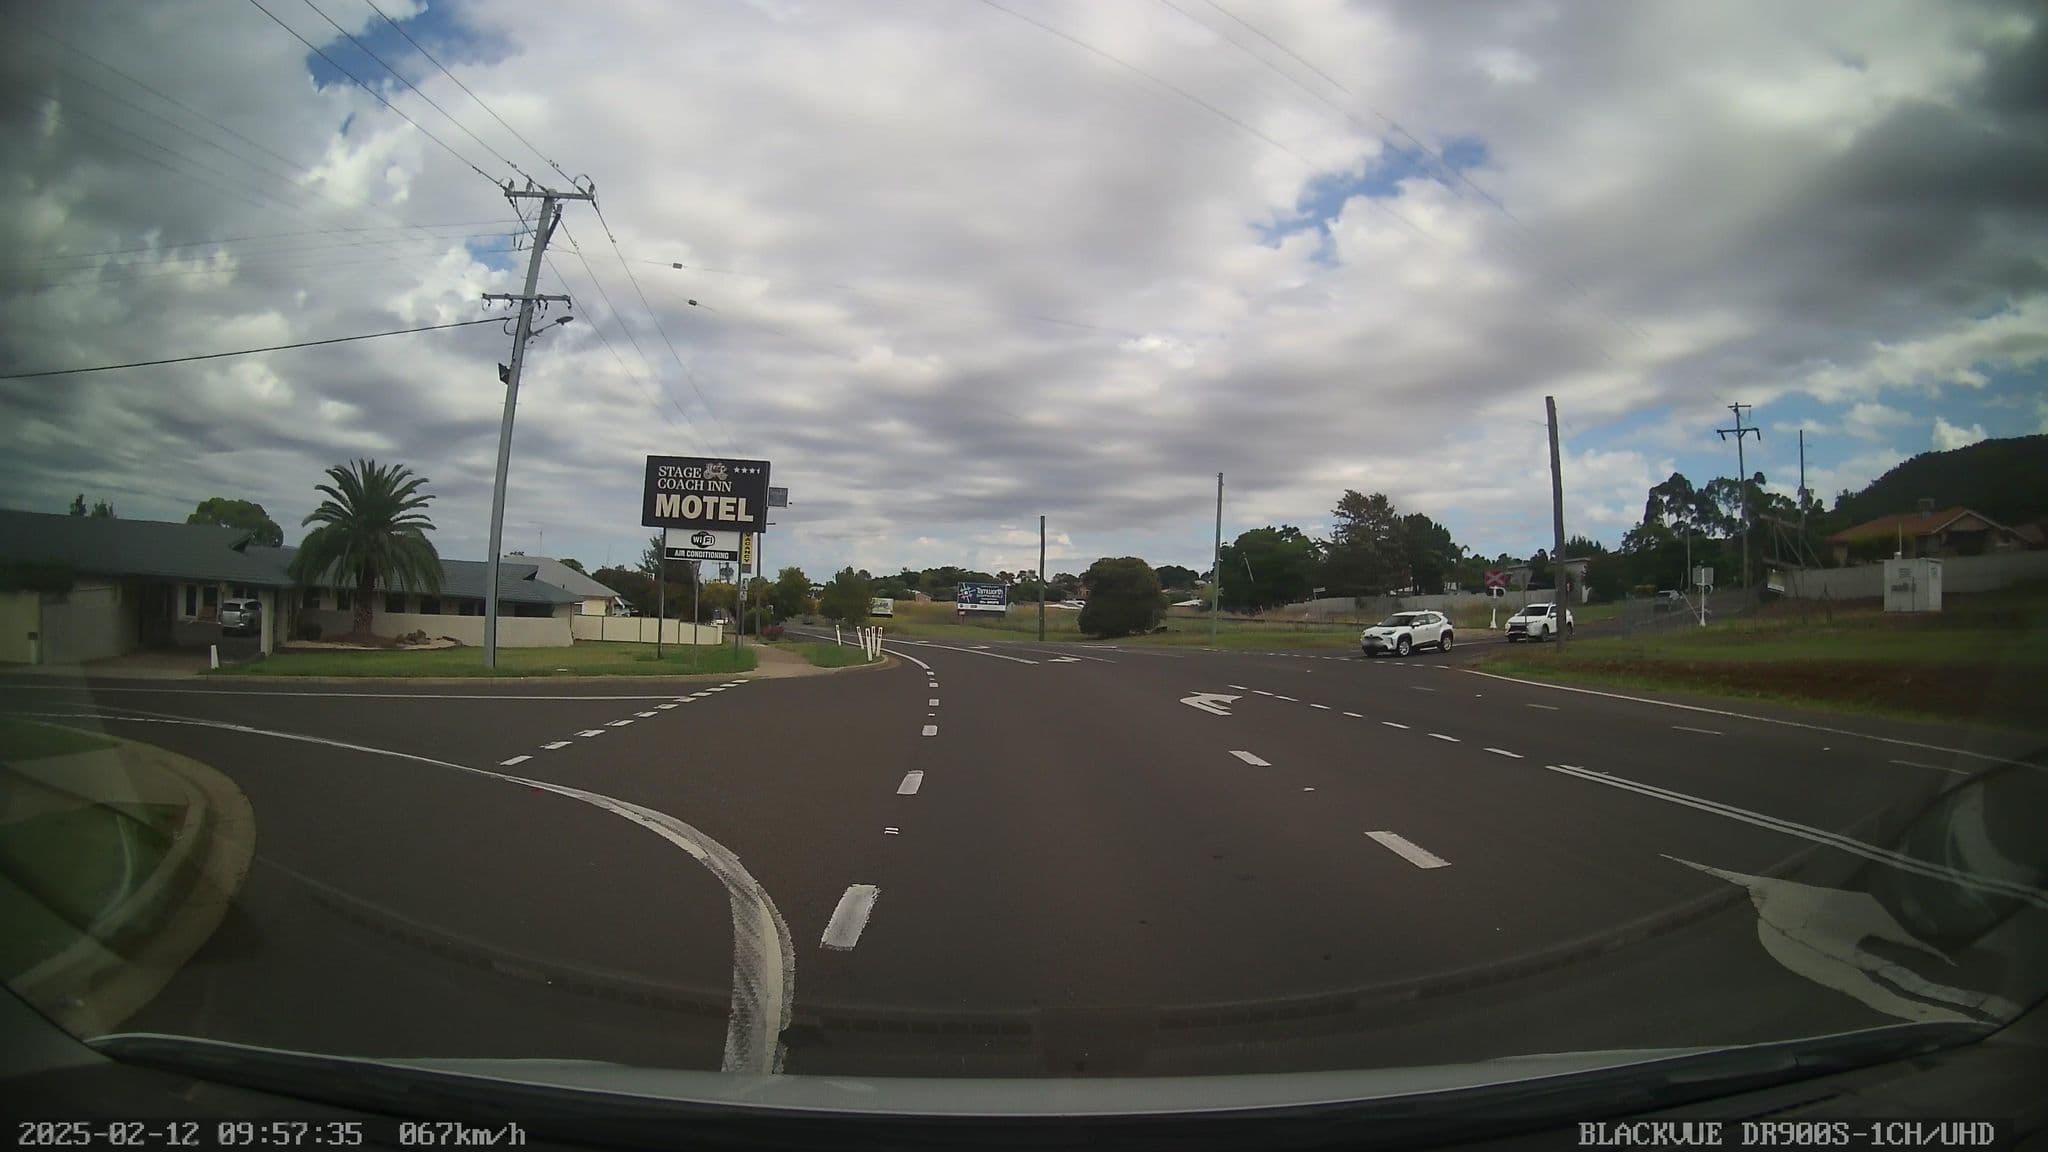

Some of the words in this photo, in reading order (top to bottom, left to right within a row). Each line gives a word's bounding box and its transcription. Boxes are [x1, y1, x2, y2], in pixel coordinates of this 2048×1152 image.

[658, 466, 701, 478] STAGE
[657, 479, 703, 491] COACH
[708, 480, 732, 492] INN
[655, 493, 754, 522] MOTEL
[674, 549, 686, 557] AIR
[686, 550, 729, 559] CONDITIONING
